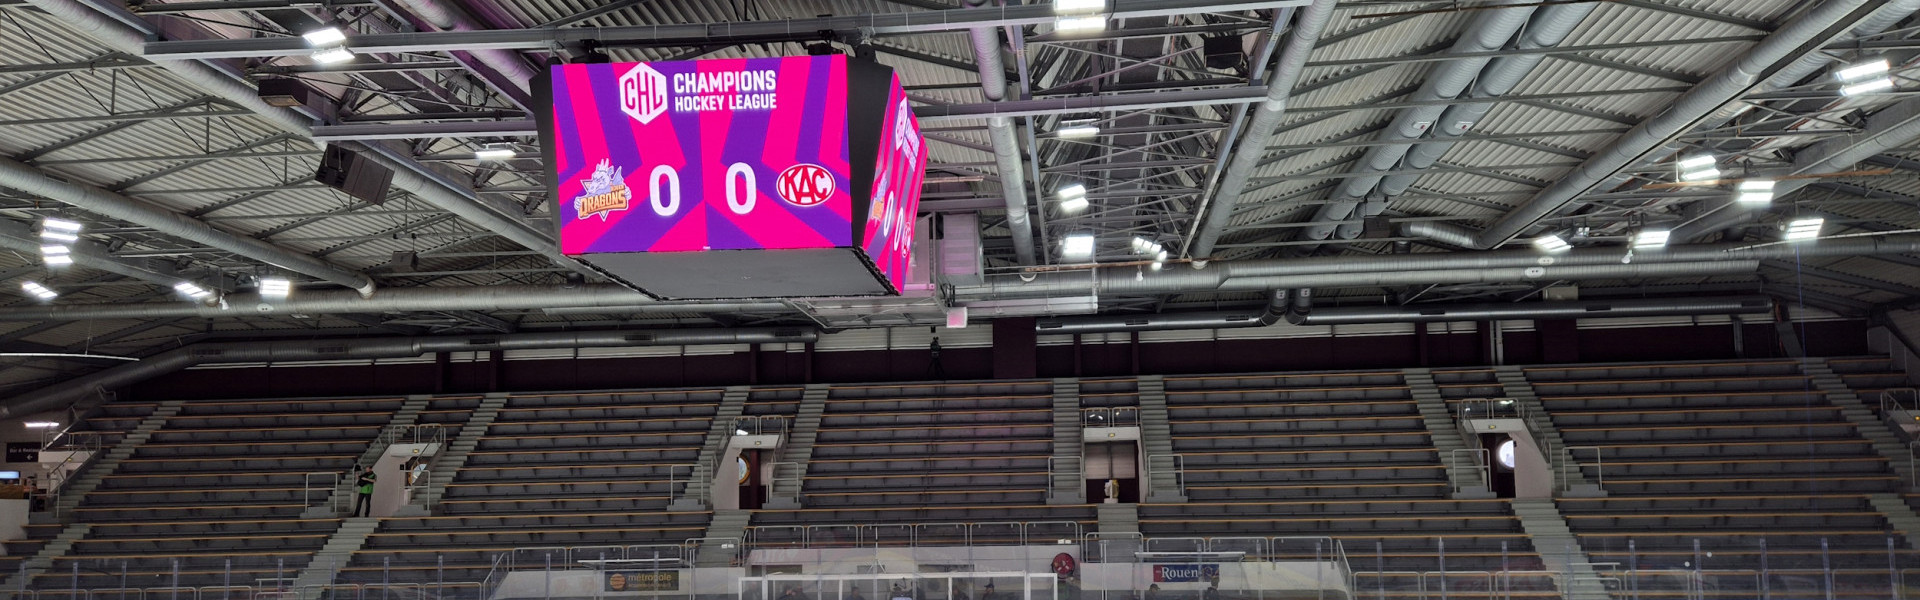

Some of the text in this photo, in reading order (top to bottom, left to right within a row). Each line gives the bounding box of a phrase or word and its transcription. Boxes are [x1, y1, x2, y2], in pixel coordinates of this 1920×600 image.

[624, 71, 663, 116] CHL
[673, 69, 777, 94] CHAMPIONS
[675, 93, 778, 113] HOCKEY LEAGUE
[649, 164, 681, 217] 0
[725, 162, 757, 215] 0
[782, 166, 829, 204] KAC
[580, 190, 627, 217] DRAGONS
[1161, 566, 1199, 580] Rouen
